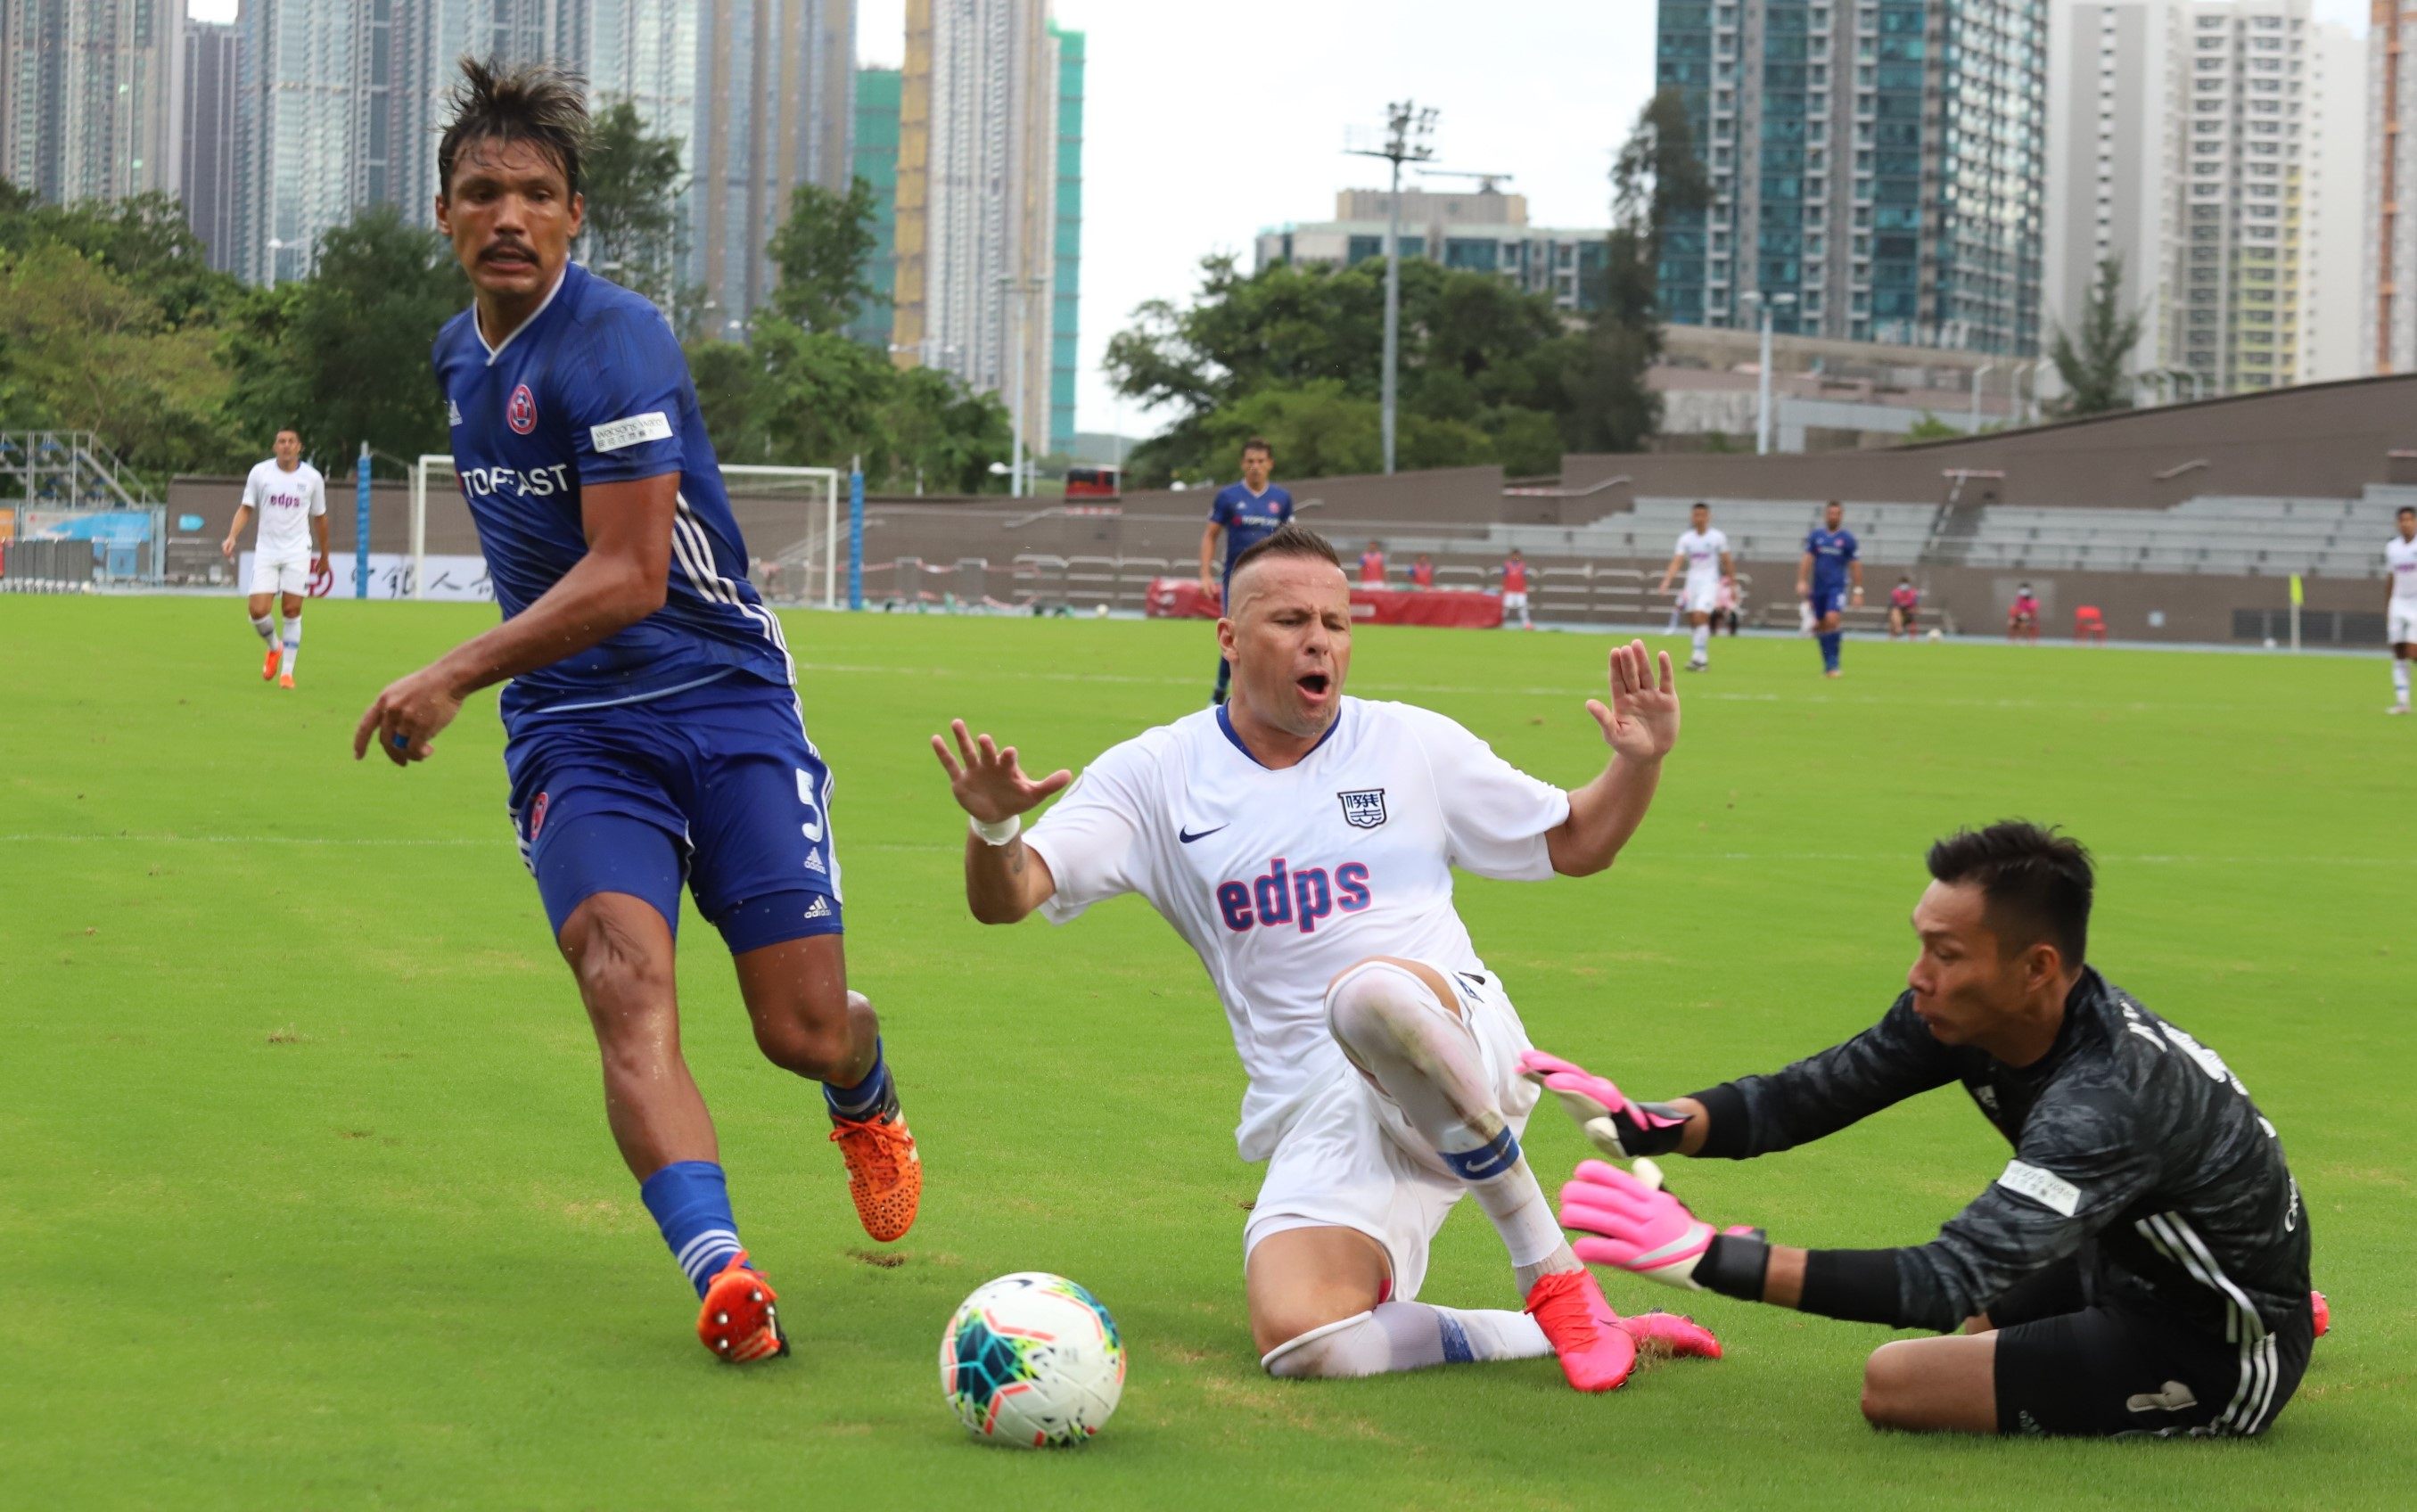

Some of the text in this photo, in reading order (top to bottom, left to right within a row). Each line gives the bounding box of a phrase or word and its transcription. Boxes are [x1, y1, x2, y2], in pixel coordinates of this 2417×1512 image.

[270, 493, 300, 509] edps
[795, 768, 824, 842] 5
[1216, 858, 1371, 933] edps
